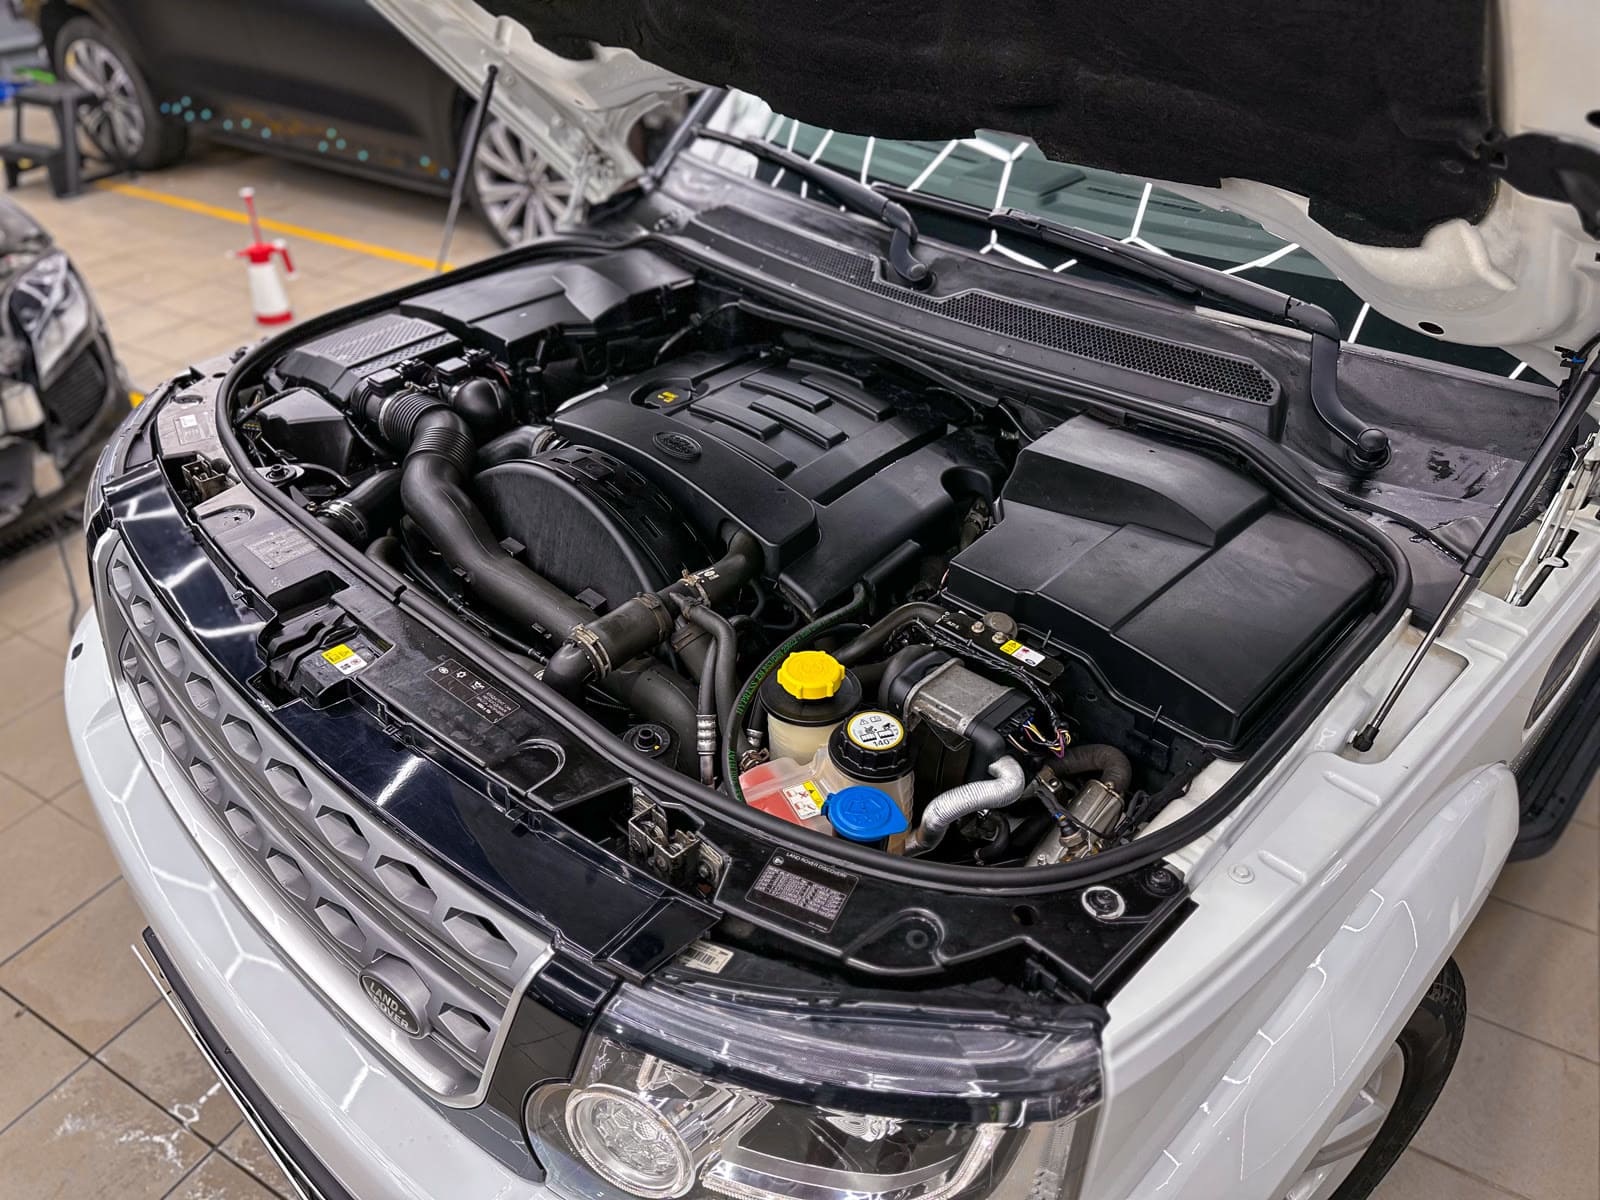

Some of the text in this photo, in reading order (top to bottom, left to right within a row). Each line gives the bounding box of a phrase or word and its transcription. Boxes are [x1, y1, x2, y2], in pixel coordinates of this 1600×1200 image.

[786, 852, 801, 861] LAND
[800, 857, 819, 868] ROVER
[370, 982, 399, 1011] LAND
[373, 996, 409, 1028] ROVER
